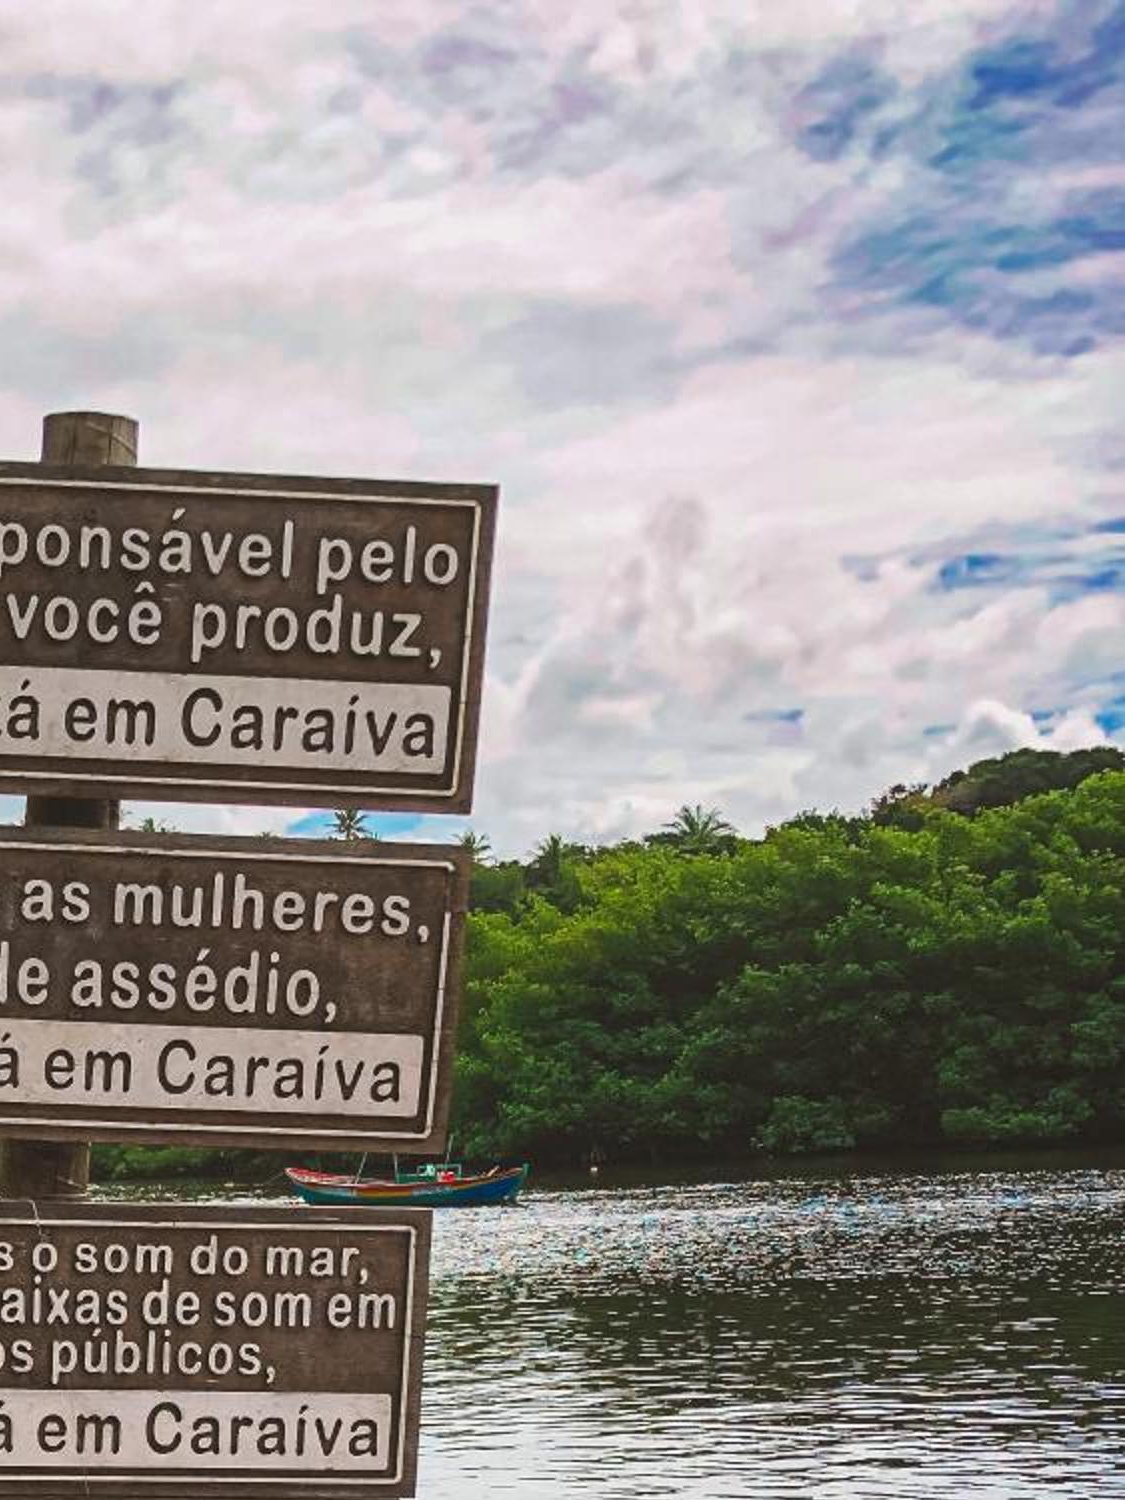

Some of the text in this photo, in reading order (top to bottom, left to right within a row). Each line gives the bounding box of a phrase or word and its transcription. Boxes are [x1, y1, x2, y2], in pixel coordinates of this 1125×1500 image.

[317, 526, 458, 594] pelo
[7, 581, 161, 644] você
[192, 594, 441, 668] produz,
[65, 698, 155, 746] em
[182, 688, 434, 758] Caraíva
[22, 880, 89, 921] as
[115, 872, 429, 942] mulheres,
[72, 949, 336, 1022] assédio,
[45, 1049, 131, 1092] em
[158, 1039, 400, 1102] Caraíva
[33, 1243, 57, 1272] o
[76, 1244, 173, 1273] som
[191, 1235, 248, 1274] do
[267, 1247, 368, 1284] mar,
[143, 1279, 199, 1324] de
[215, 1292, 311, 1327] som
[328, 1294, 395, 1328] em
[52, 1328, 275, 1384] públicos,
[37, 1414, 121, 1454] em
[146, 1402, 377, 1456] Caraíva
